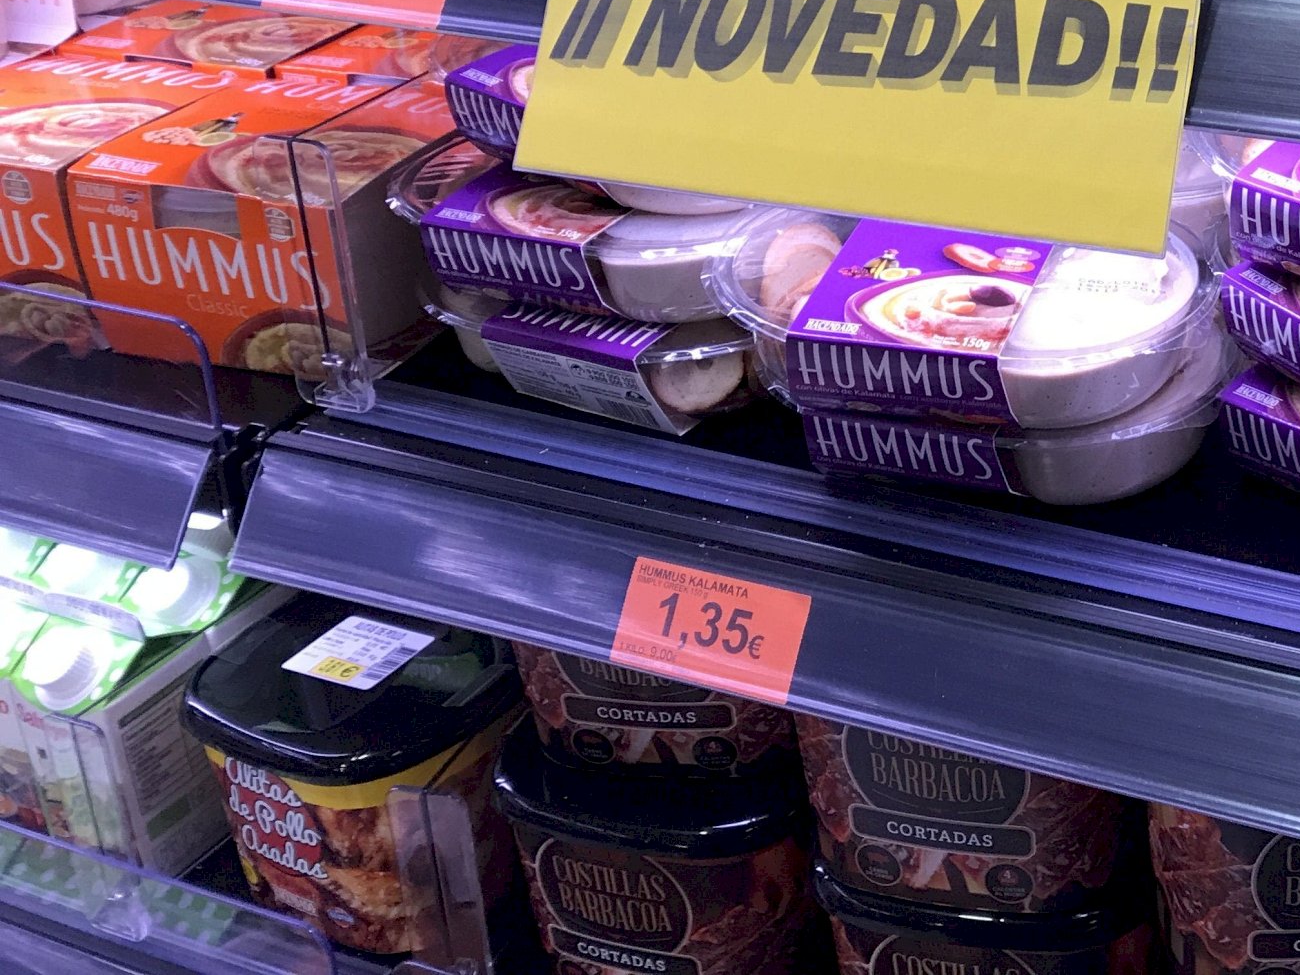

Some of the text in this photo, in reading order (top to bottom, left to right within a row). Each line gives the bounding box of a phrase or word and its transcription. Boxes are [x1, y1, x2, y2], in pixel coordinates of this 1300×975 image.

[105, 203, 139, 222] 480g
[88, 221, 331, 311] HUMMUS
[427, 225, 586, 291] HUMMUS
[186, 293, 250, 319] Classic
[805, 318, 861, 335] HACENDADO
[961, 335, 991, 351] 150g
[797, 340, 995, 403] HUMMUS
[1235, 384, 1281, 408] HACENDADO
[813, 415, 993, 480] HUMMUS
[639, 564, 749, 599] HUMMUS KALAMATA
[659, 592, 765, 660] 1,35€
[596, 706, 697, 724] CORTADAS
[870, 752, 1006, 803] BARBACOA
[228, 784, 321, 846] de Pollo
[886, 821, 993, 848] CORTADAS
[553, 855, 666, 902] COSTILLAS
[559, 882, 673, 933] BARBACOA
[577, 941, 667, 972] CORTADAS
